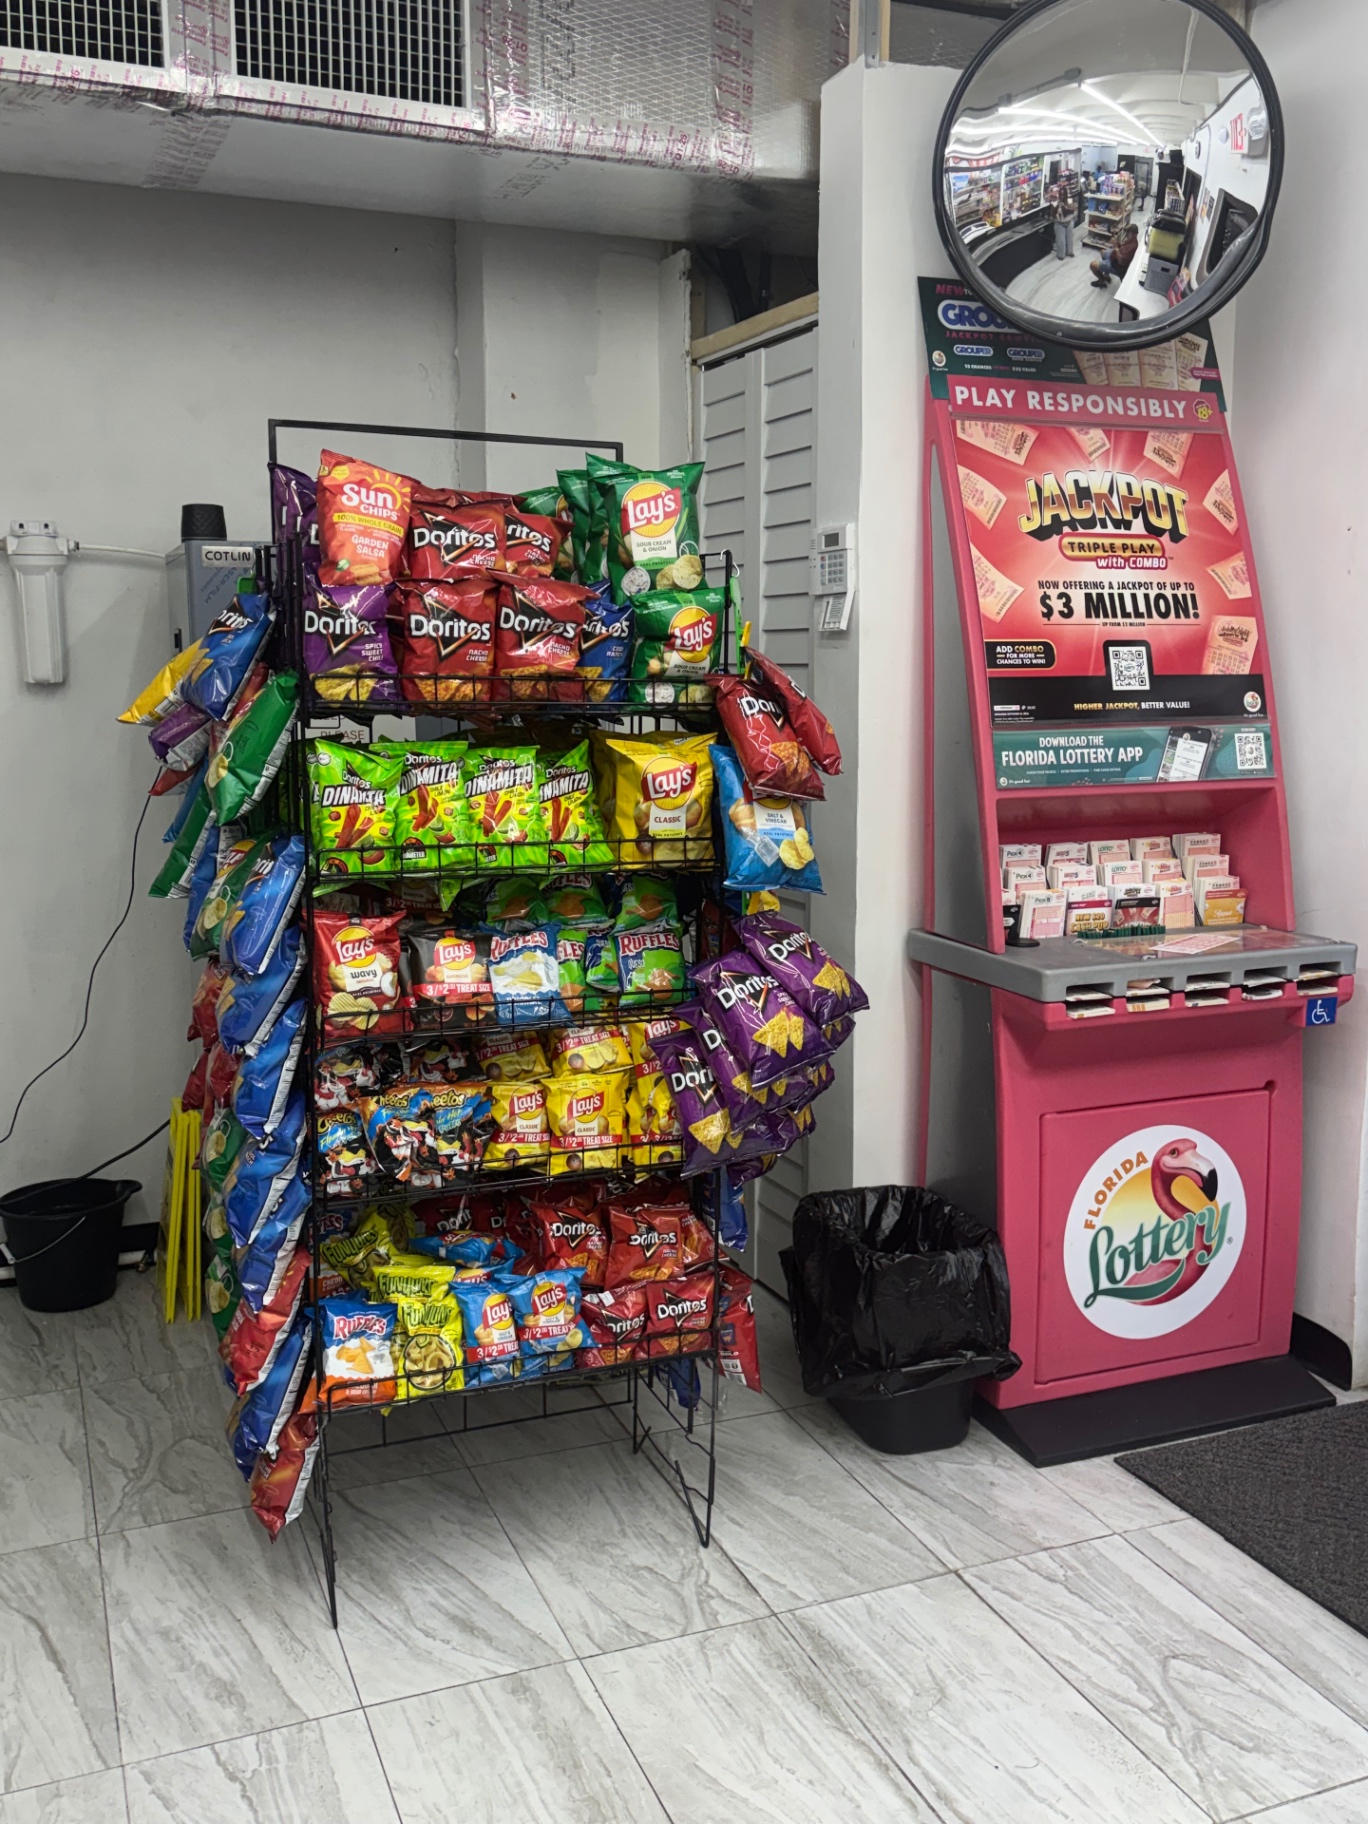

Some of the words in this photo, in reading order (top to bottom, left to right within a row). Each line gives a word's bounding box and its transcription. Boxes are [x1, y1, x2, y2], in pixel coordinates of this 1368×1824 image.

[716, 159, 740, 175] Q1-26
[936, 284, 965, 296] NEW
[945, 331, 994, 341] JACKPOT
[955, 346, 992, 355] GROUPER
[955, 386, 1016, 409] PLAY
[1027, 390, 1187, 419] RESPONSIBLY
[341, 483, 393, 509] Sun
[360, 504, 398, 521] CHIPS
[627, 490, 676, 529] Lay's
[1018, 470, 1190, 543] JACKPOT
[357, 516, 381, 528] WHOLE
[383, 521, 402, 535] GRAIN
[351, 534, 389, 550] GARDEN
[413, 527, 496, 550] Doritos
[1067, 541, 1116, 554] TRIPLE
[1121, 543, 1156, 554] PLAY
[204, 550, 251, 561] COTLIN
[355, 544, 385, 558] SALSA
[1097, 557, 1125, 568] with
[1128, 558, 1168, 569] COMBO
[1038, 580, 1059, 590] NOW
[1062, 581, 1106, 591] OFFERING
[1108, 581, 1114, 590] A
[1117, 581, 1153, 591] JACKPOT
[1157, 582, 1168, 591] OF
[1170, 581, 1182, 591] UP
[1184, 582, 1195, 591] TO
[1039, 591, 1075, 622] $3
[1084, 592, 1200, 621] MILLION!
[409, 613, 491, 641] Doritos
[500, 606, 577, 639] Doritos
[674, 617, 713, 652] Lay's
[365, 642, 383, 650] SPICY
[1014, 645, 1044, 653] COMBO
[1105, 702, 1139, 711] JACKPOT,
[1166, 701, 1191, 709] VALUE!
[1039, 736, 1087, 747] DOWNLOAD
[1088, 736, 1103, 746] THE
[405, 753, 443, 765] Doritos
[1002, 750, 1057, 766] FLORIDA
[1060, 748, 1114, 764] LOTTERY
[1118, 747, 1143, 762] APP
[342, 768, 372, 789] Doritos
[400, 761, 458, 796] DINAMITA
[465, 763, 534, 798] DINAMITA
[546, 765, 577, 779] Doritos
[646, 765, 693, 799] Lay's
[654, 815, 682, 824] CLASSIC
[336, 936, 375, 963] Lay's
[438, 942, 473, 965] Lay's
[490, 931, 549, 962] RUFFLES
[619, 933, 680, 957] RUFFLES
[350, 969, 377, 980] wavy
[456, 983, 477, 993] TREAT
[479, 983, 490, 992] SIZE
[717, 974, 779, 1009] Doritos
[498, 1043, 517, 1053] TREAT
[518, 1039, 530, 1048] SIZE
[580, 1032, 599, 1044] TREAT
[513, 1092, 543, 1115] Lay's
[572, 1095, 601, 1118] Lay's
[524, 1132, 542, 1141] TREAT
[583, 1135, 602, 1145] TREAT
[602, 1135, 613, 1143] SIZE
[1084, 1151, 1148, 1230] FLORIDA
[1084, 1202, 1231, 1308] Lottery
[534, 1286, 563, 1312] Lay's
[657, 1297, 707, 1319] Doritos
[334, 1314, 388, 1341] RUFFLES
[548, 1325, 570, 1336] TREAT
